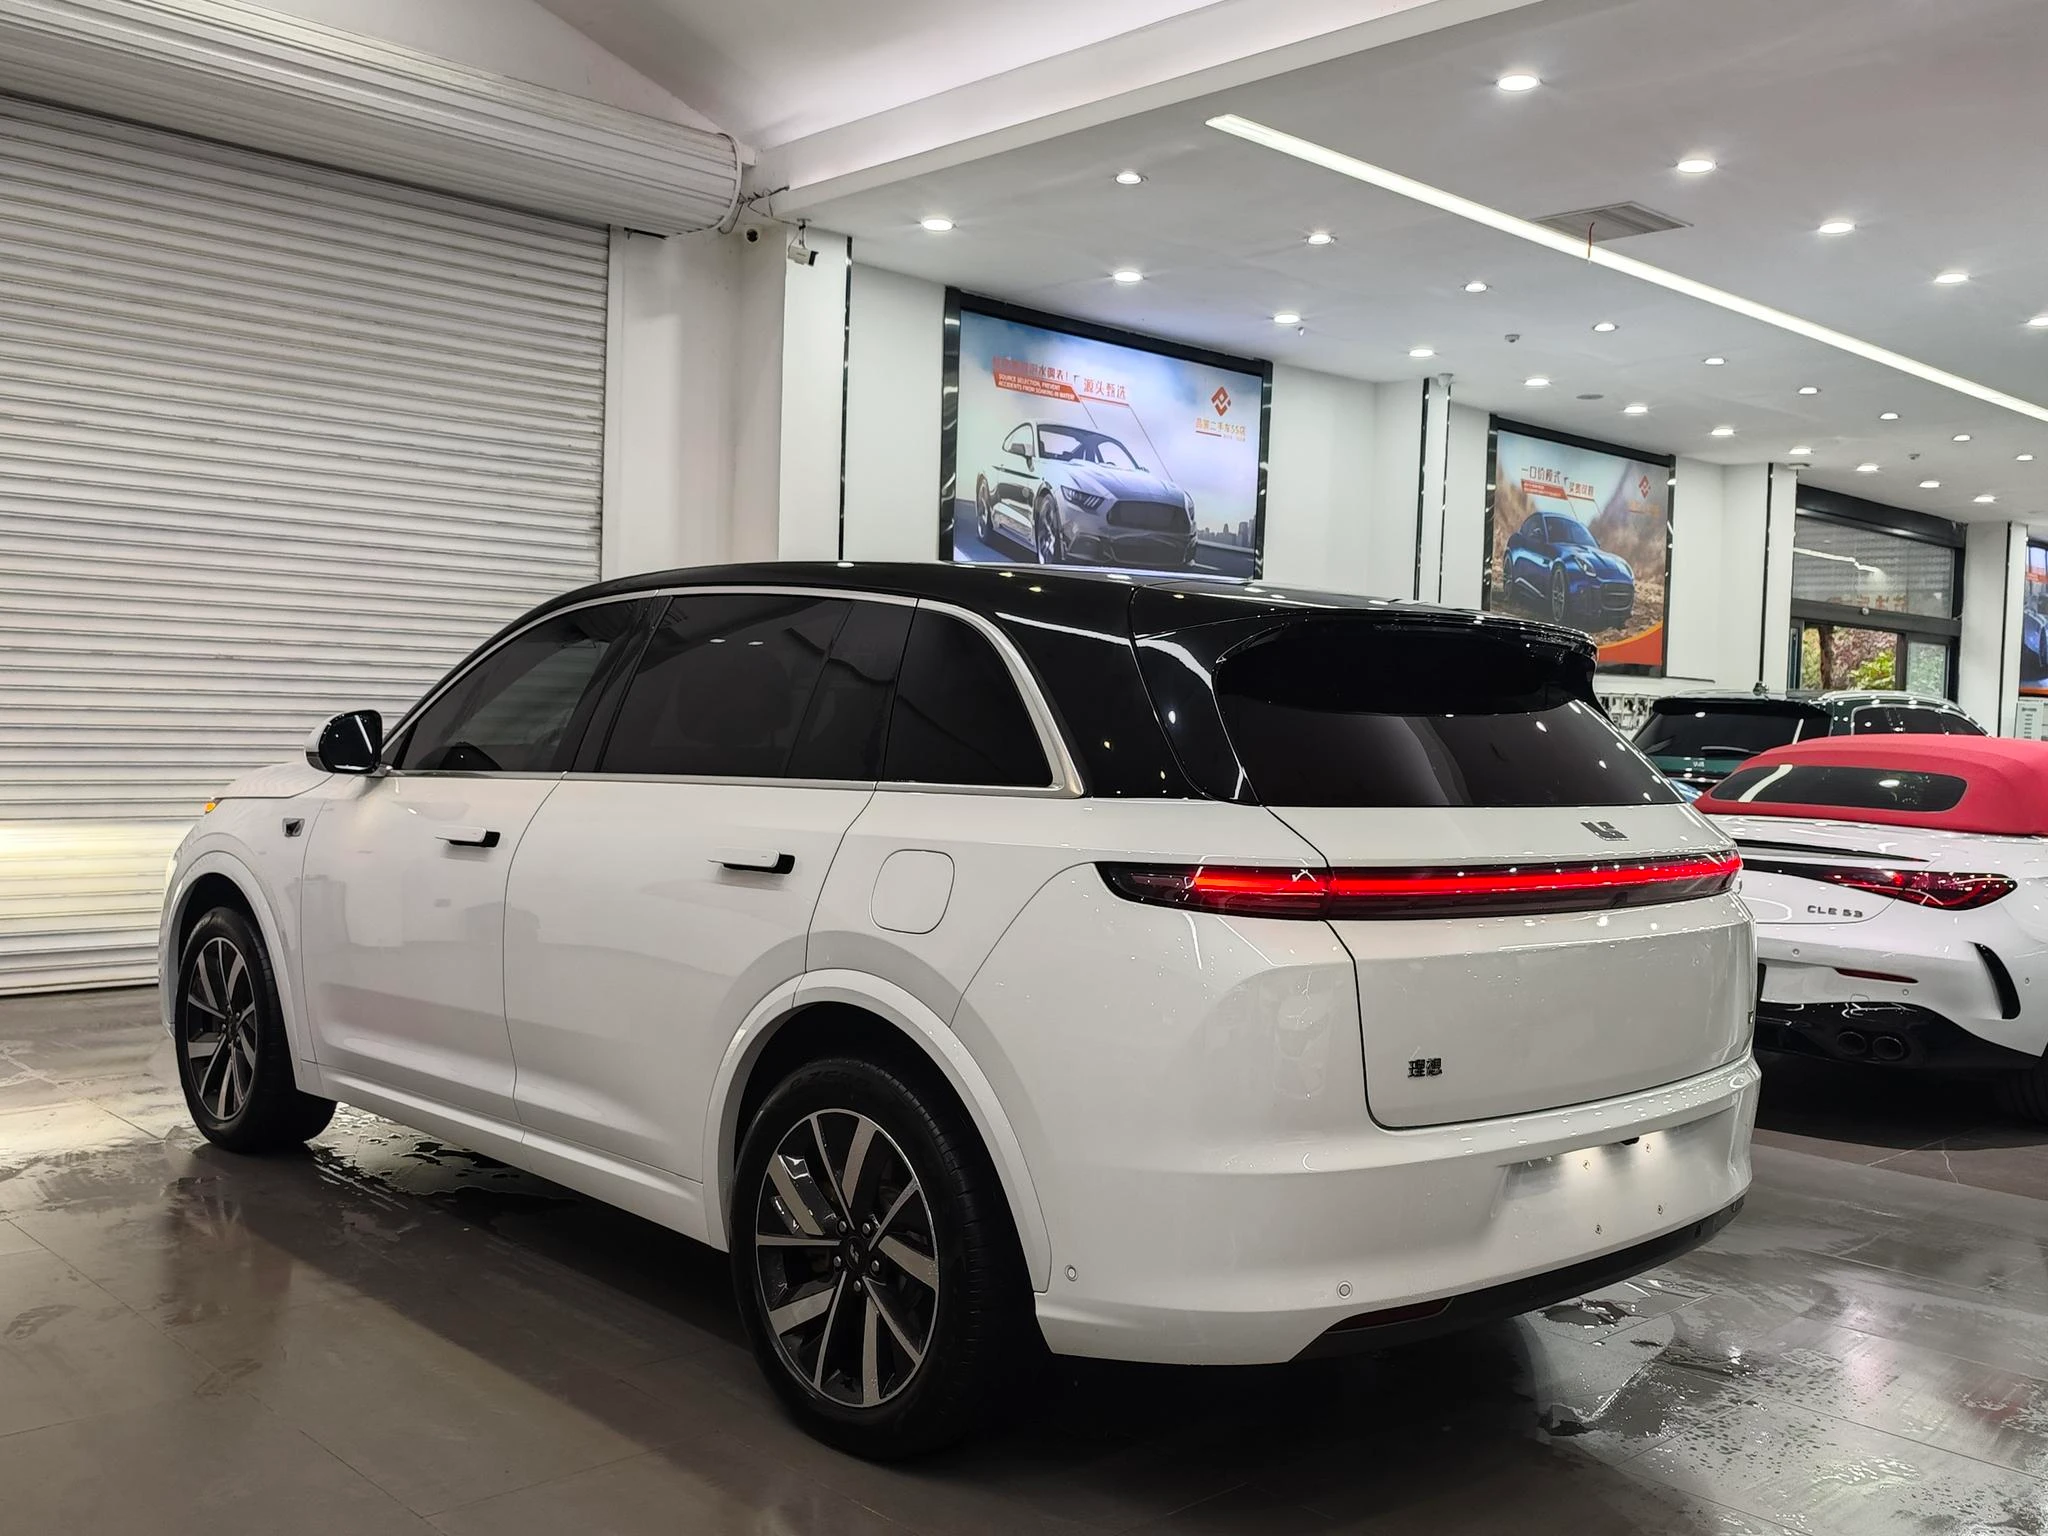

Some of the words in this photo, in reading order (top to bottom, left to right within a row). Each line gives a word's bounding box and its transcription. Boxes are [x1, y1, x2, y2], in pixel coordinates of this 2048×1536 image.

[1521, 465, 1561, 484] 一口价模式
[1807, 905, 1837, 915] CLE
[1843, 909, 1863, 918] 53
